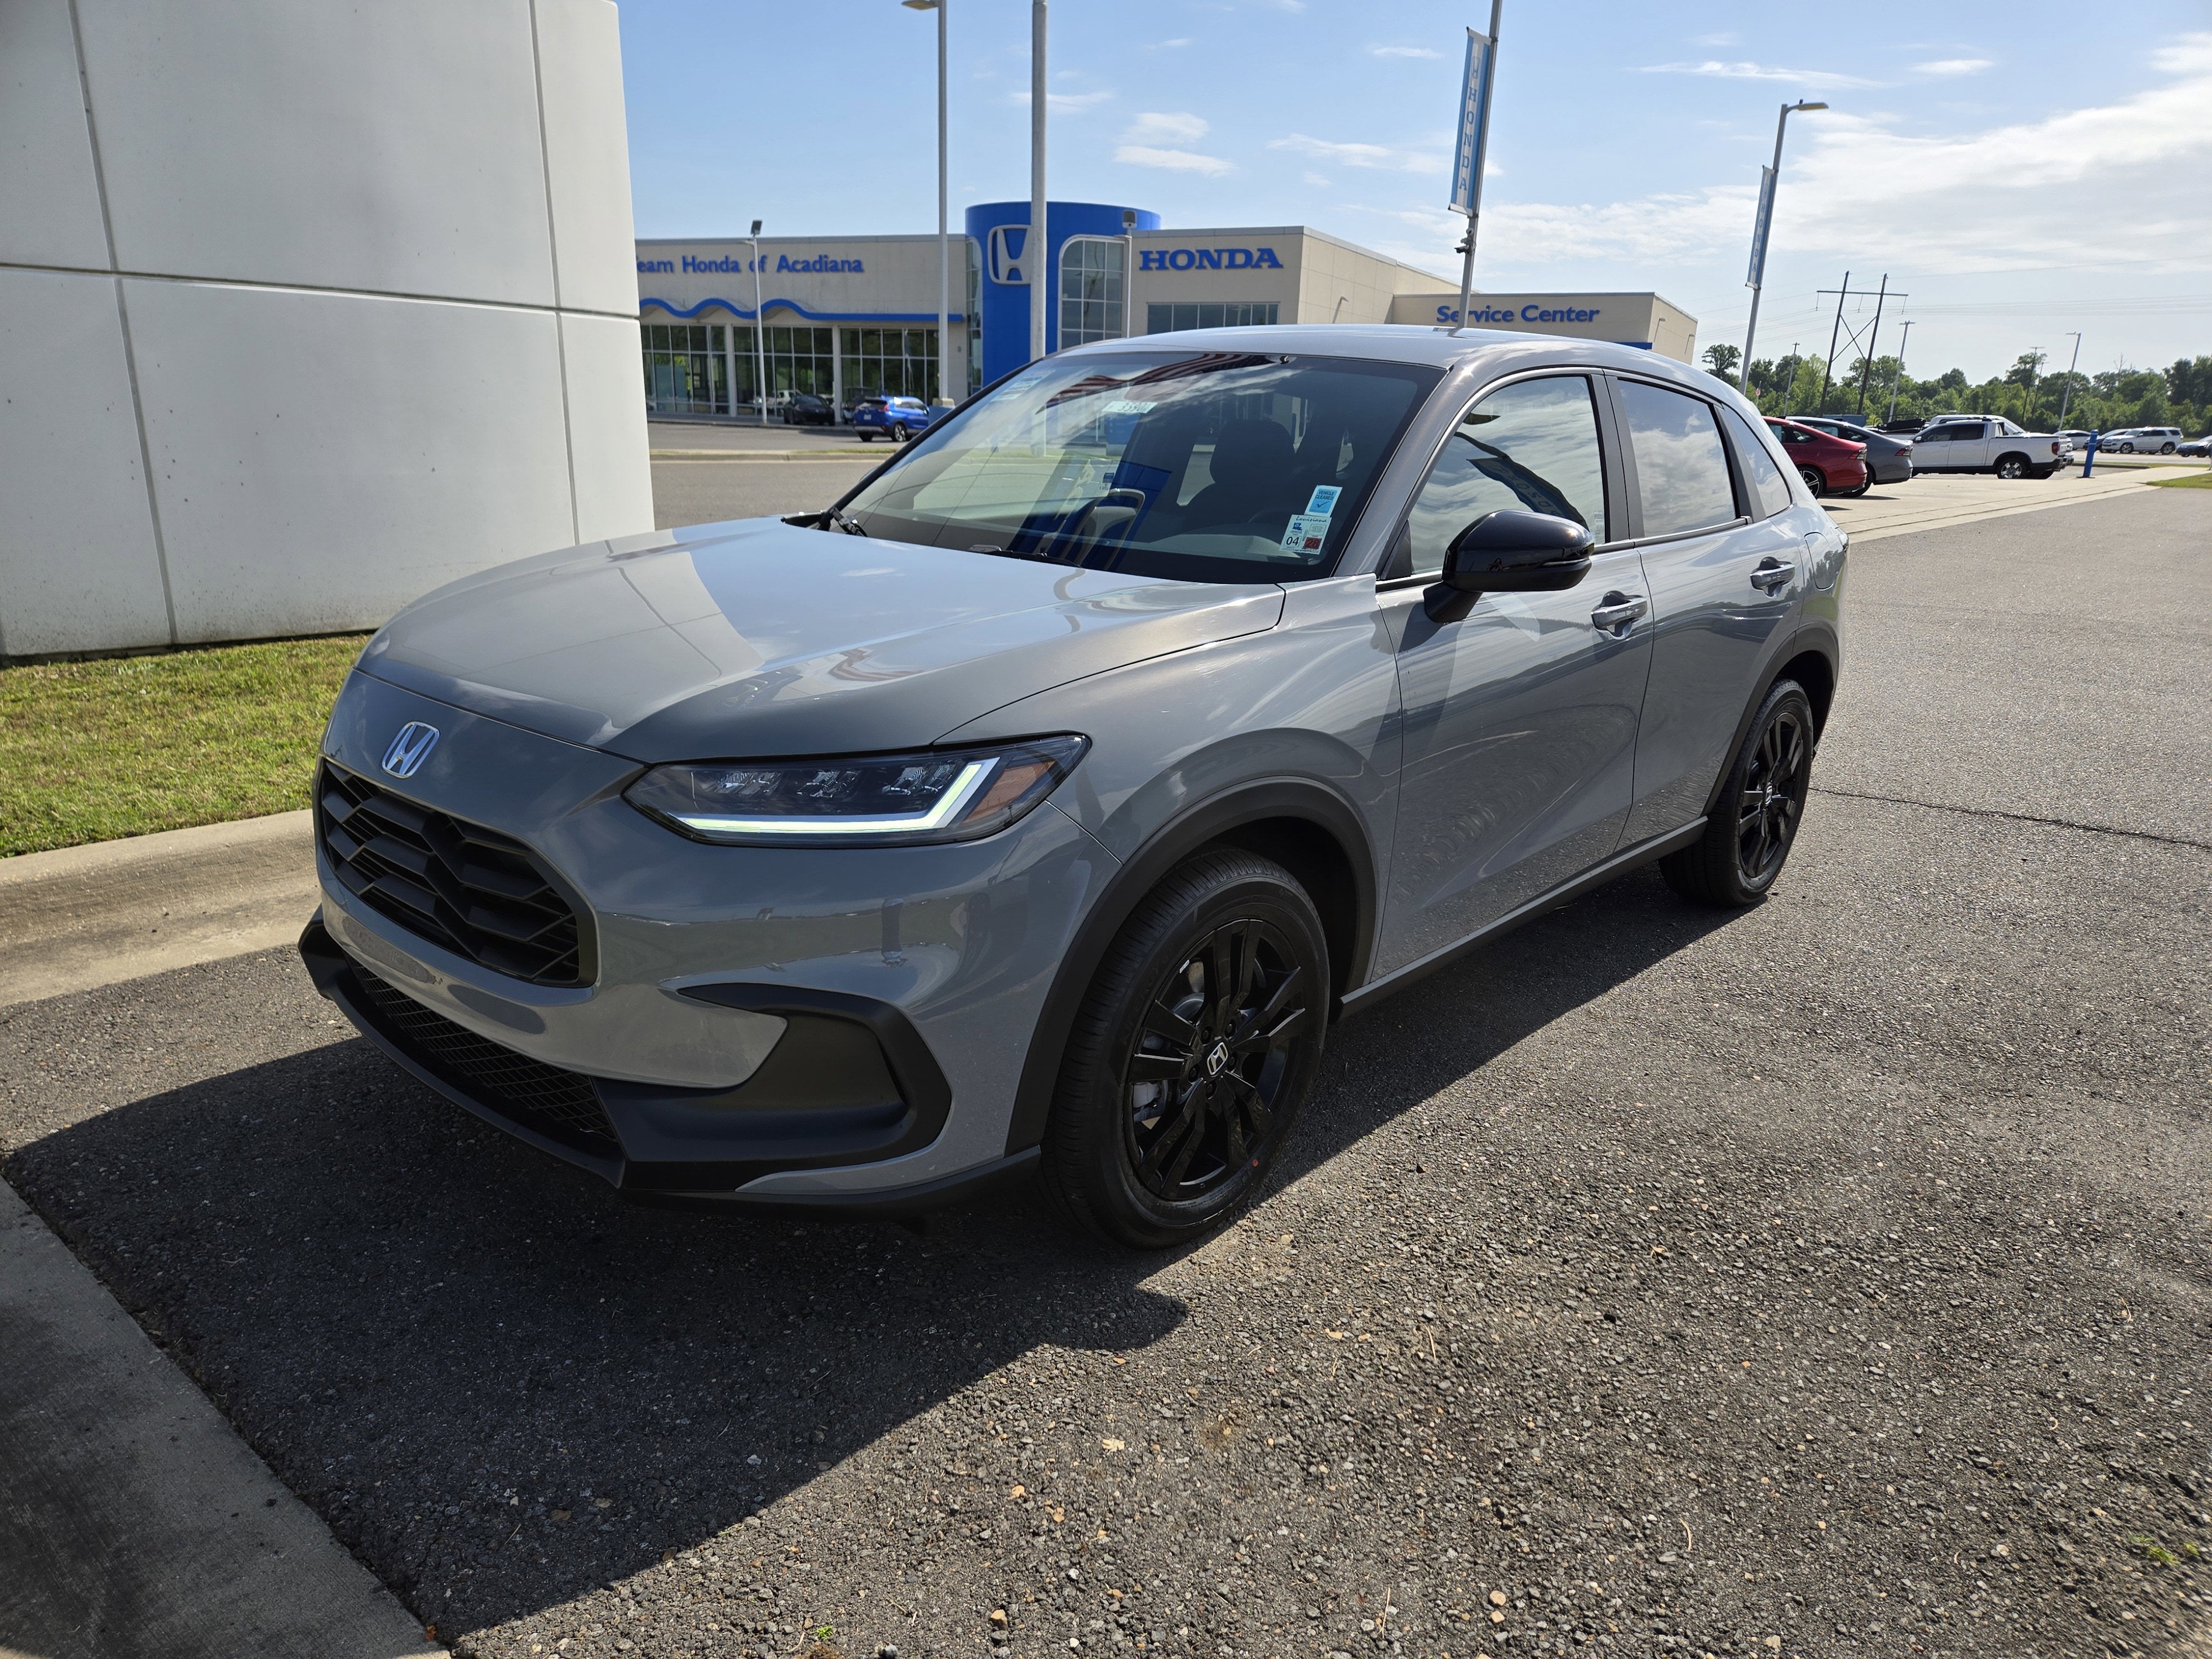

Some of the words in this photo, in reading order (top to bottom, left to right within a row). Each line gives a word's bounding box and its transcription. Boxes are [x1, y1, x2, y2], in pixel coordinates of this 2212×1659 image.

[1458, 86, 1478, 191] HONDA
[636, 255, 674, 273] eam
[682, 254, 741, 273] Honda
[776, 254, 864, 273] Acadiana
[1139, 248, 1284, 270] HONDA
[1521, 304, 1600, 322] Center
[1286, 536, 1299, 546] 04
[1307, 539, 1319, 547] 28
